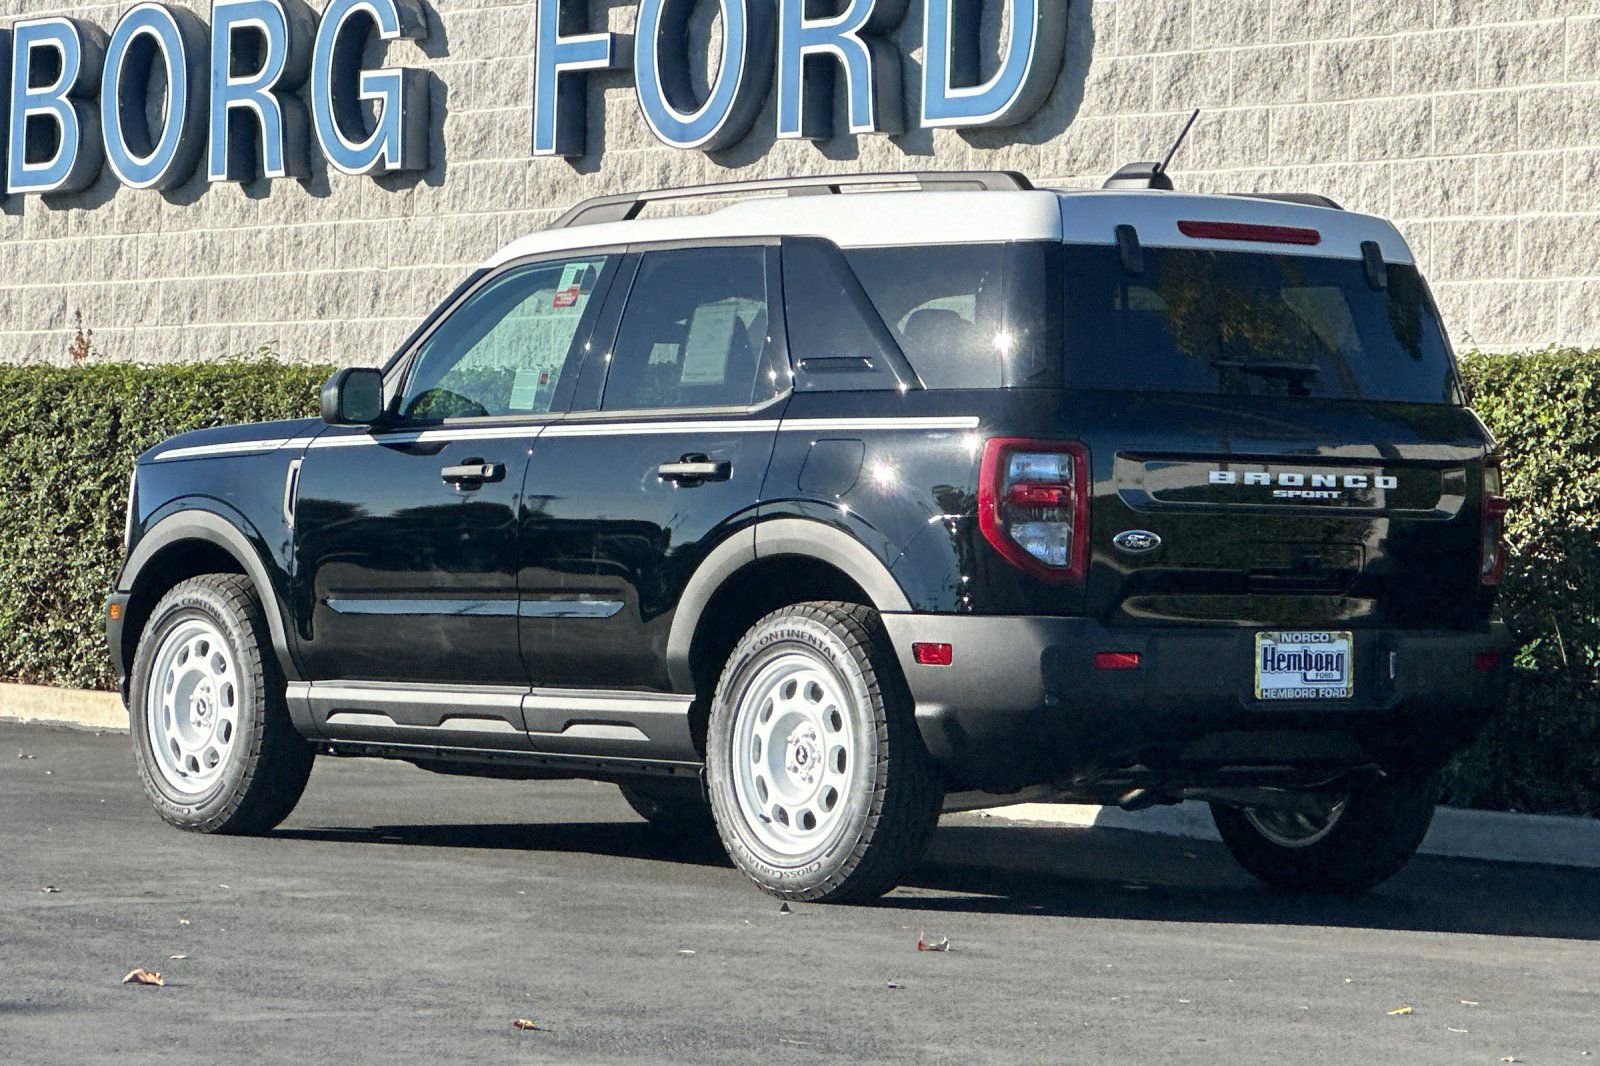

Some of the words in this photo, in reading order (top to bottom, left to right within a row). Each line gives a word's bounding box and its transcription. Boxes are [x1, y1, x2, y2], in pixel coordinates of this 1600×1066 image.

[6, 0, 404, 194] BORG
[532, 0, 1042, 156] FORD
[1208, 470, 1398, 489] BRONCO
[1272, 489, 1342, 499] SPORT
[752, 629, 836, 661] CONTINENTAL
[1280, 633, 1330, 643] NORCO
[1263, 688, 1317, 699] HEMBORG
[1319, 688, 1347, 698] FORD
